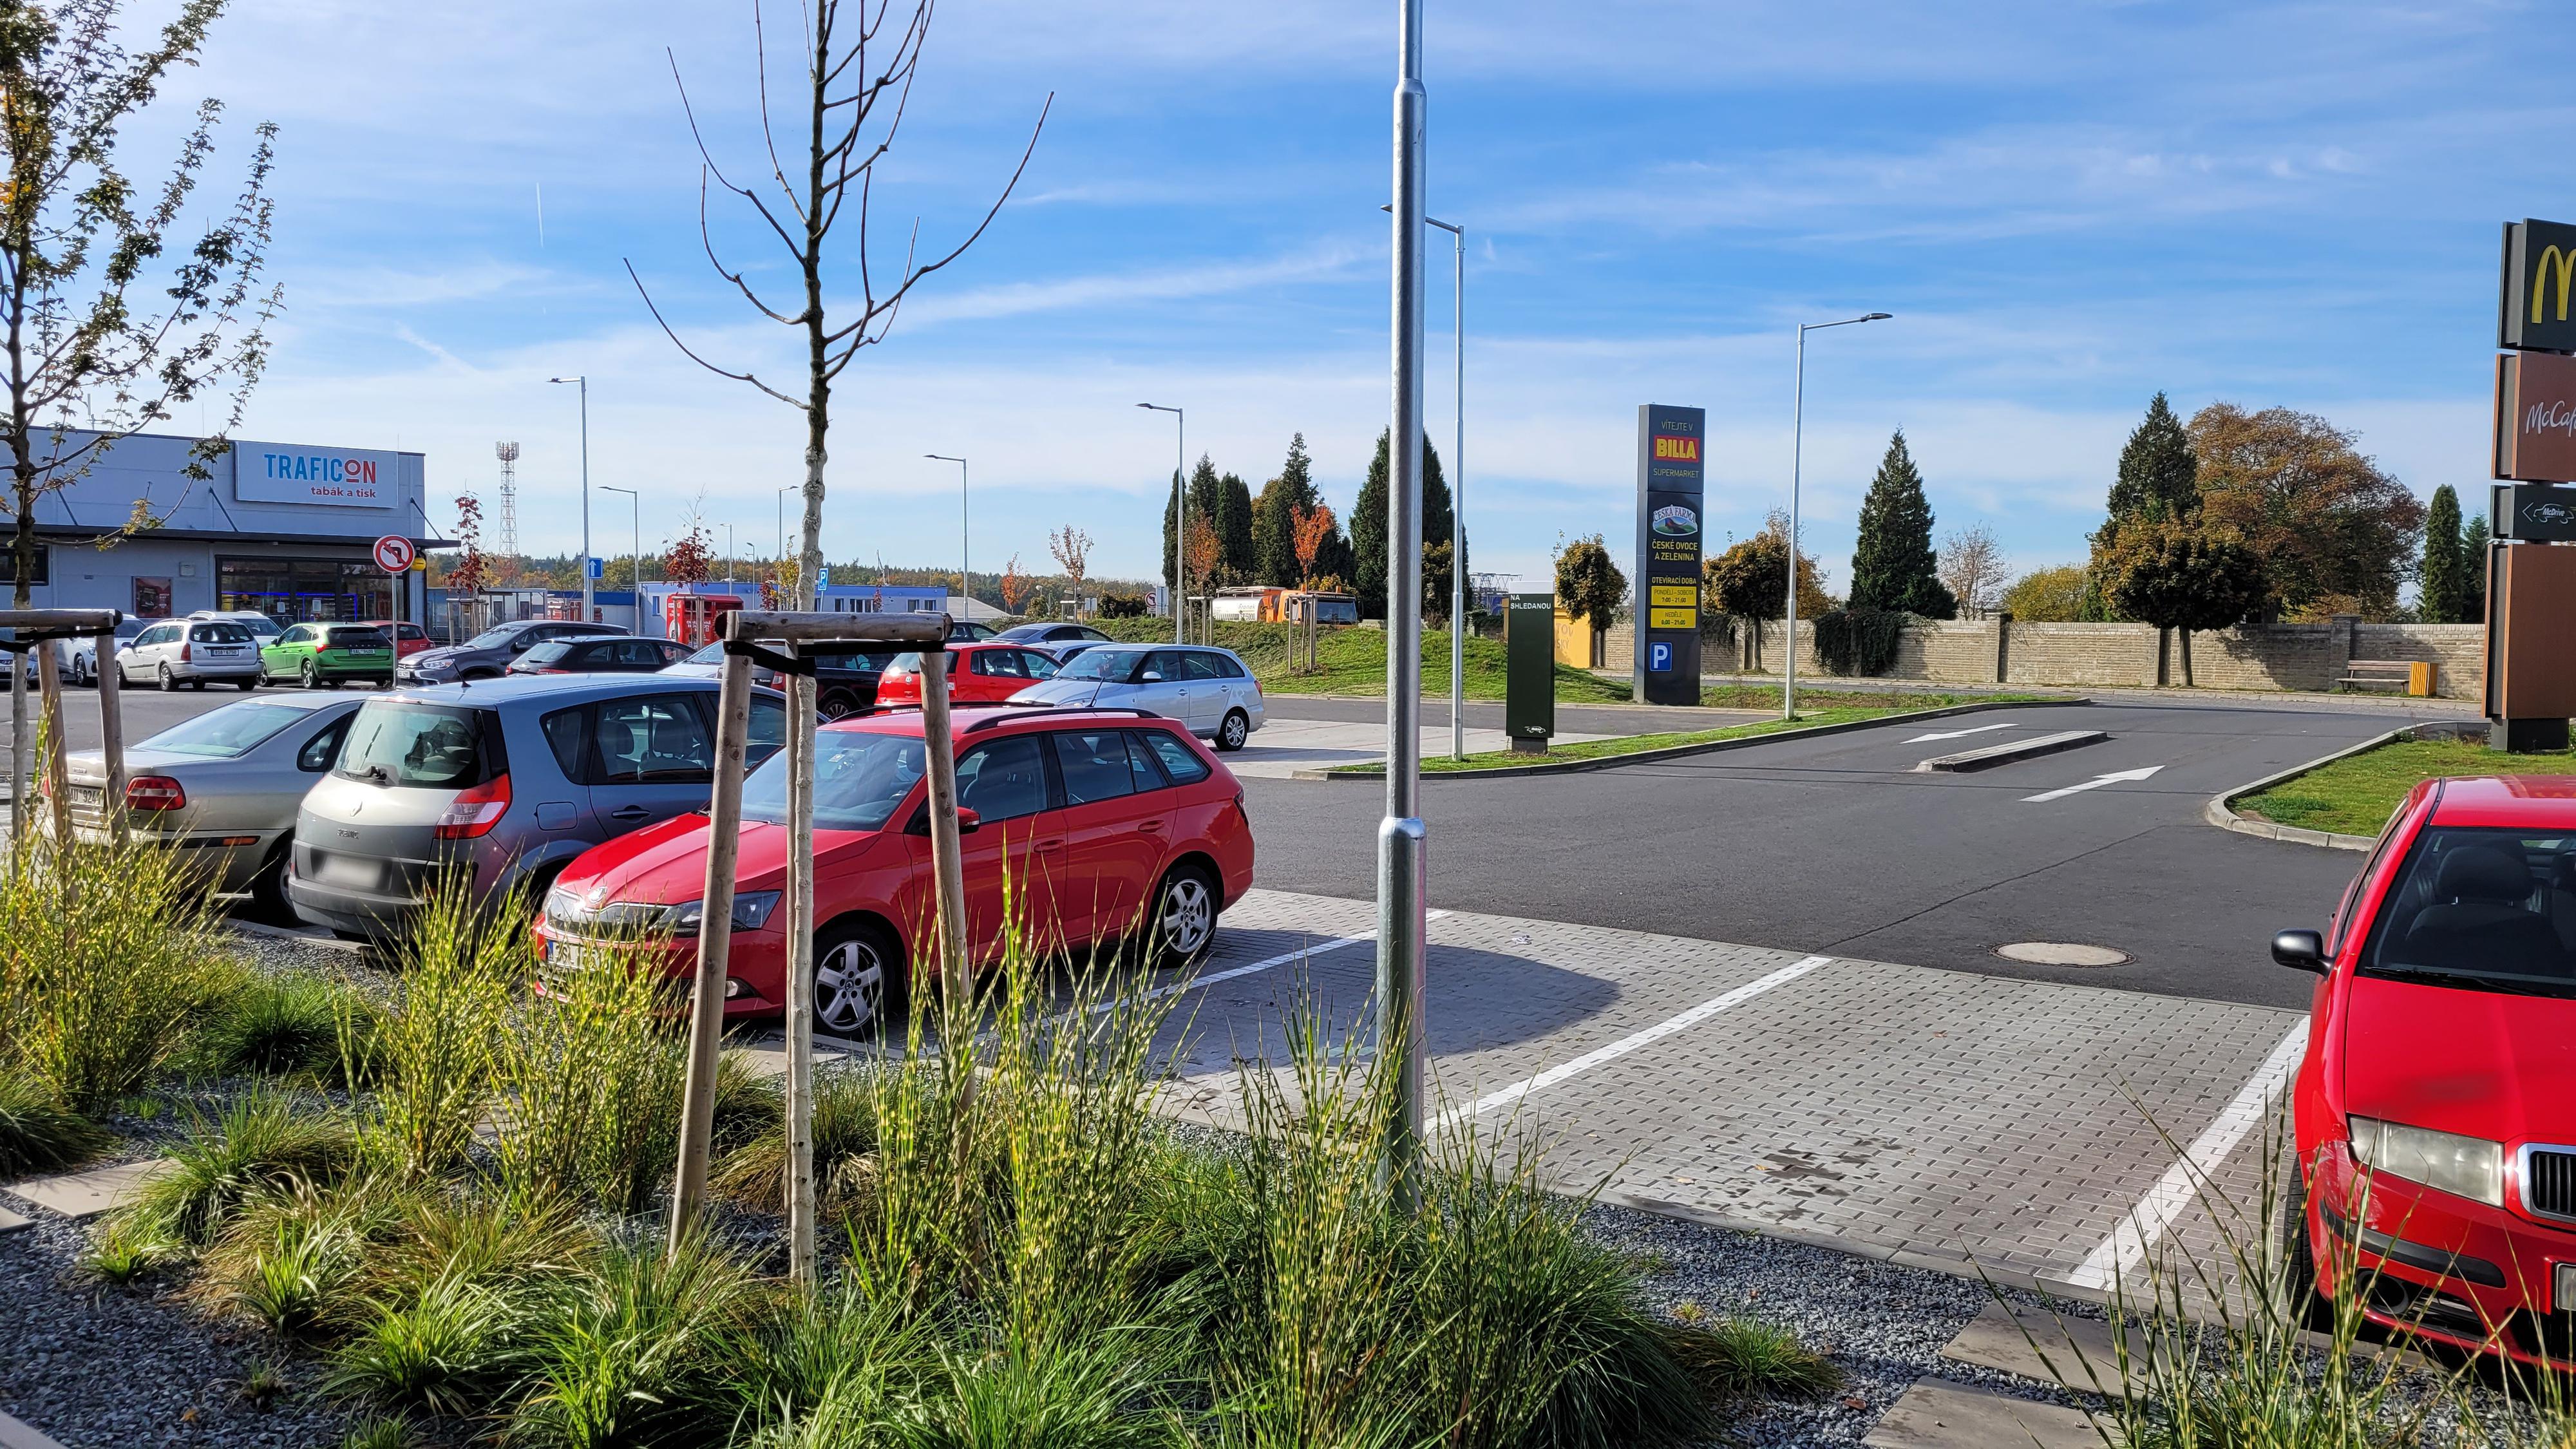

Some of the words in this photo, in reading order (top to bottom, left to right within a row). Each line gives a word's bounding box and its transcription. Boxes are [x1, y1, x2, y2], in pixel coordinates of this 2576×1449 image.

[2526, 400, 2576, 437] McCaf
[1662, 419, 1687, 431] VÍTEJTE
[1689, 423, 1693, 431] V
[1656, 438, 1696, 459] BILLA
[264, 454, 376, 484] TRAFICON
[1653, 468, 1700, 478] SUPERMARKET
[311, 486, 344, 497] tabák
[357, 488, 376, 498] tisk
[1654, 505, 1673, 521] ČESKÁ
[1675, 507, 1696, 523] FARMA
[2543, 507, 2565, 516] McDrive
[1652, 538, 1674, 549] ČESKÉ
[1676, 542, 1698, 551] OVOCE
[1661, 553, 1694, 561] ZELENINA
[820, 571, 826, 583] P
[1652, 575, 1681, 583] OTEVÍRACÍ
[1654, 645, 1668, 668] P
